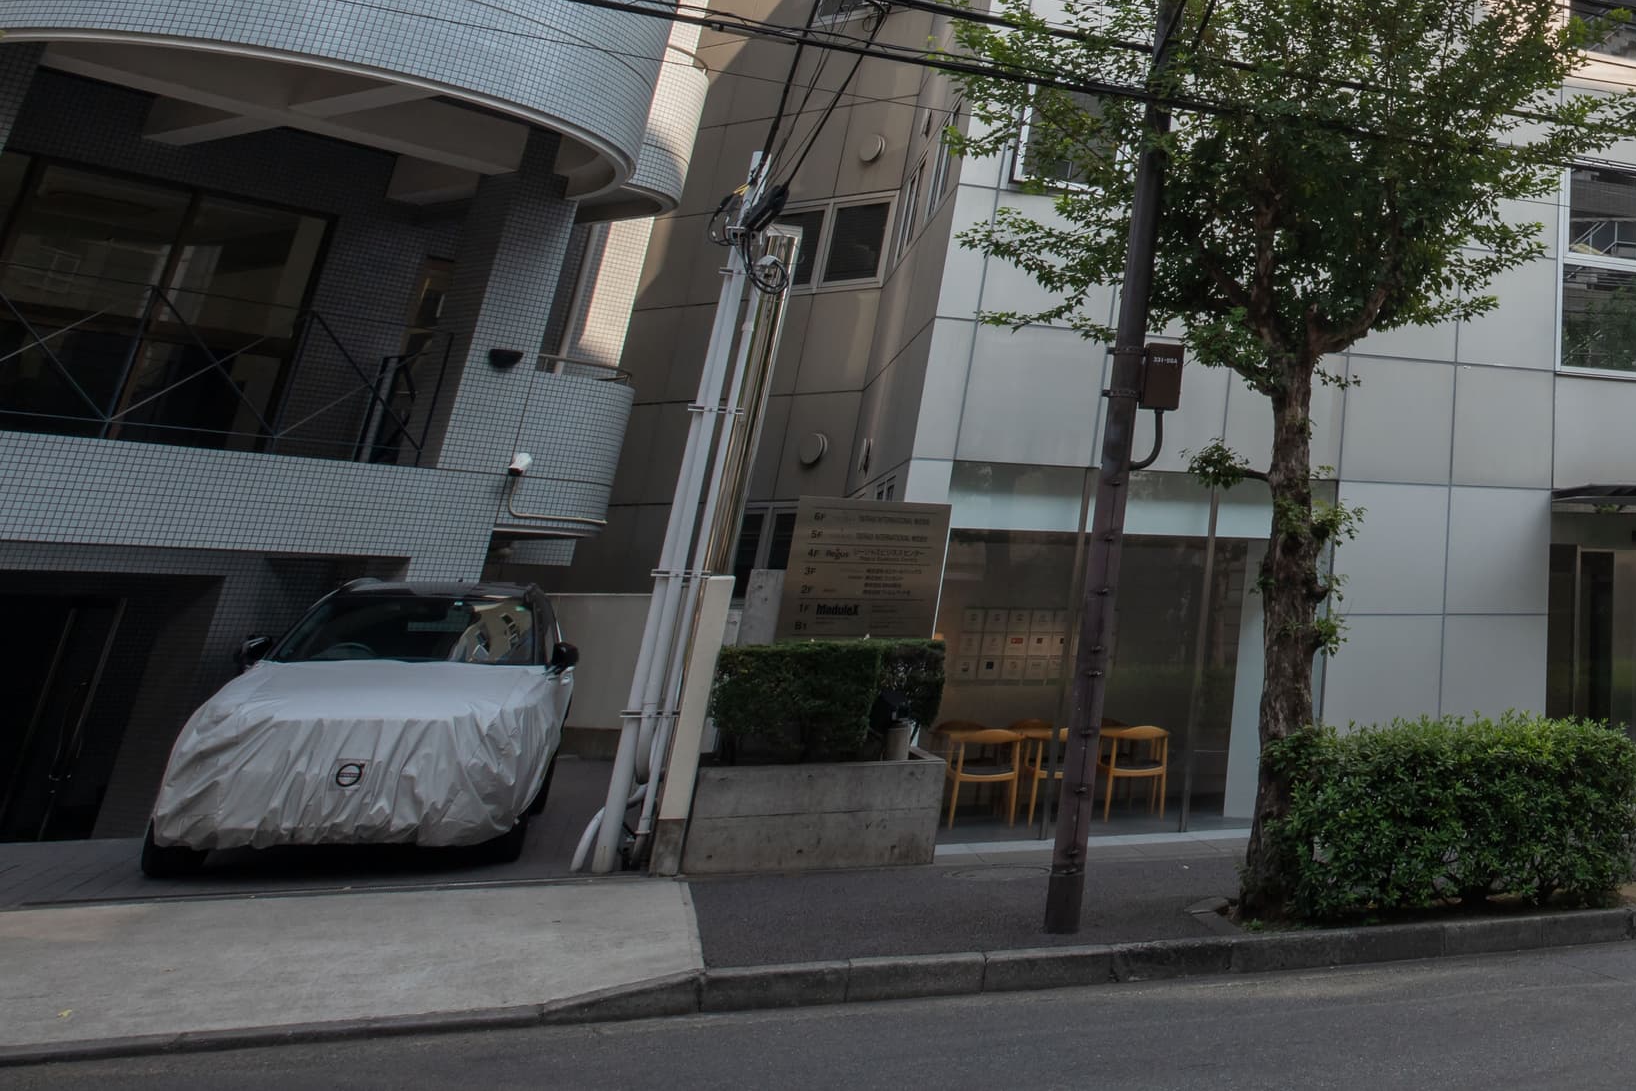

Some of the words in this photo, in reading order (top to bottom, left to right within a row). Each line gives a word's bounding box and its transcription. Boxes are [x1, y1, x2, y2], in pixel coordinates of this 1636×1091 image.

[814, 512, 825, 521] 6F
[811, 529, 823, 539] 5F
[808, 548, 819, 559] 4F
[825, 548, 849, 560] Regus
[804, 567, 816, 575] 3F
[801, 585, 814, 594] 2F
[794, 621, 807, 630] B1
